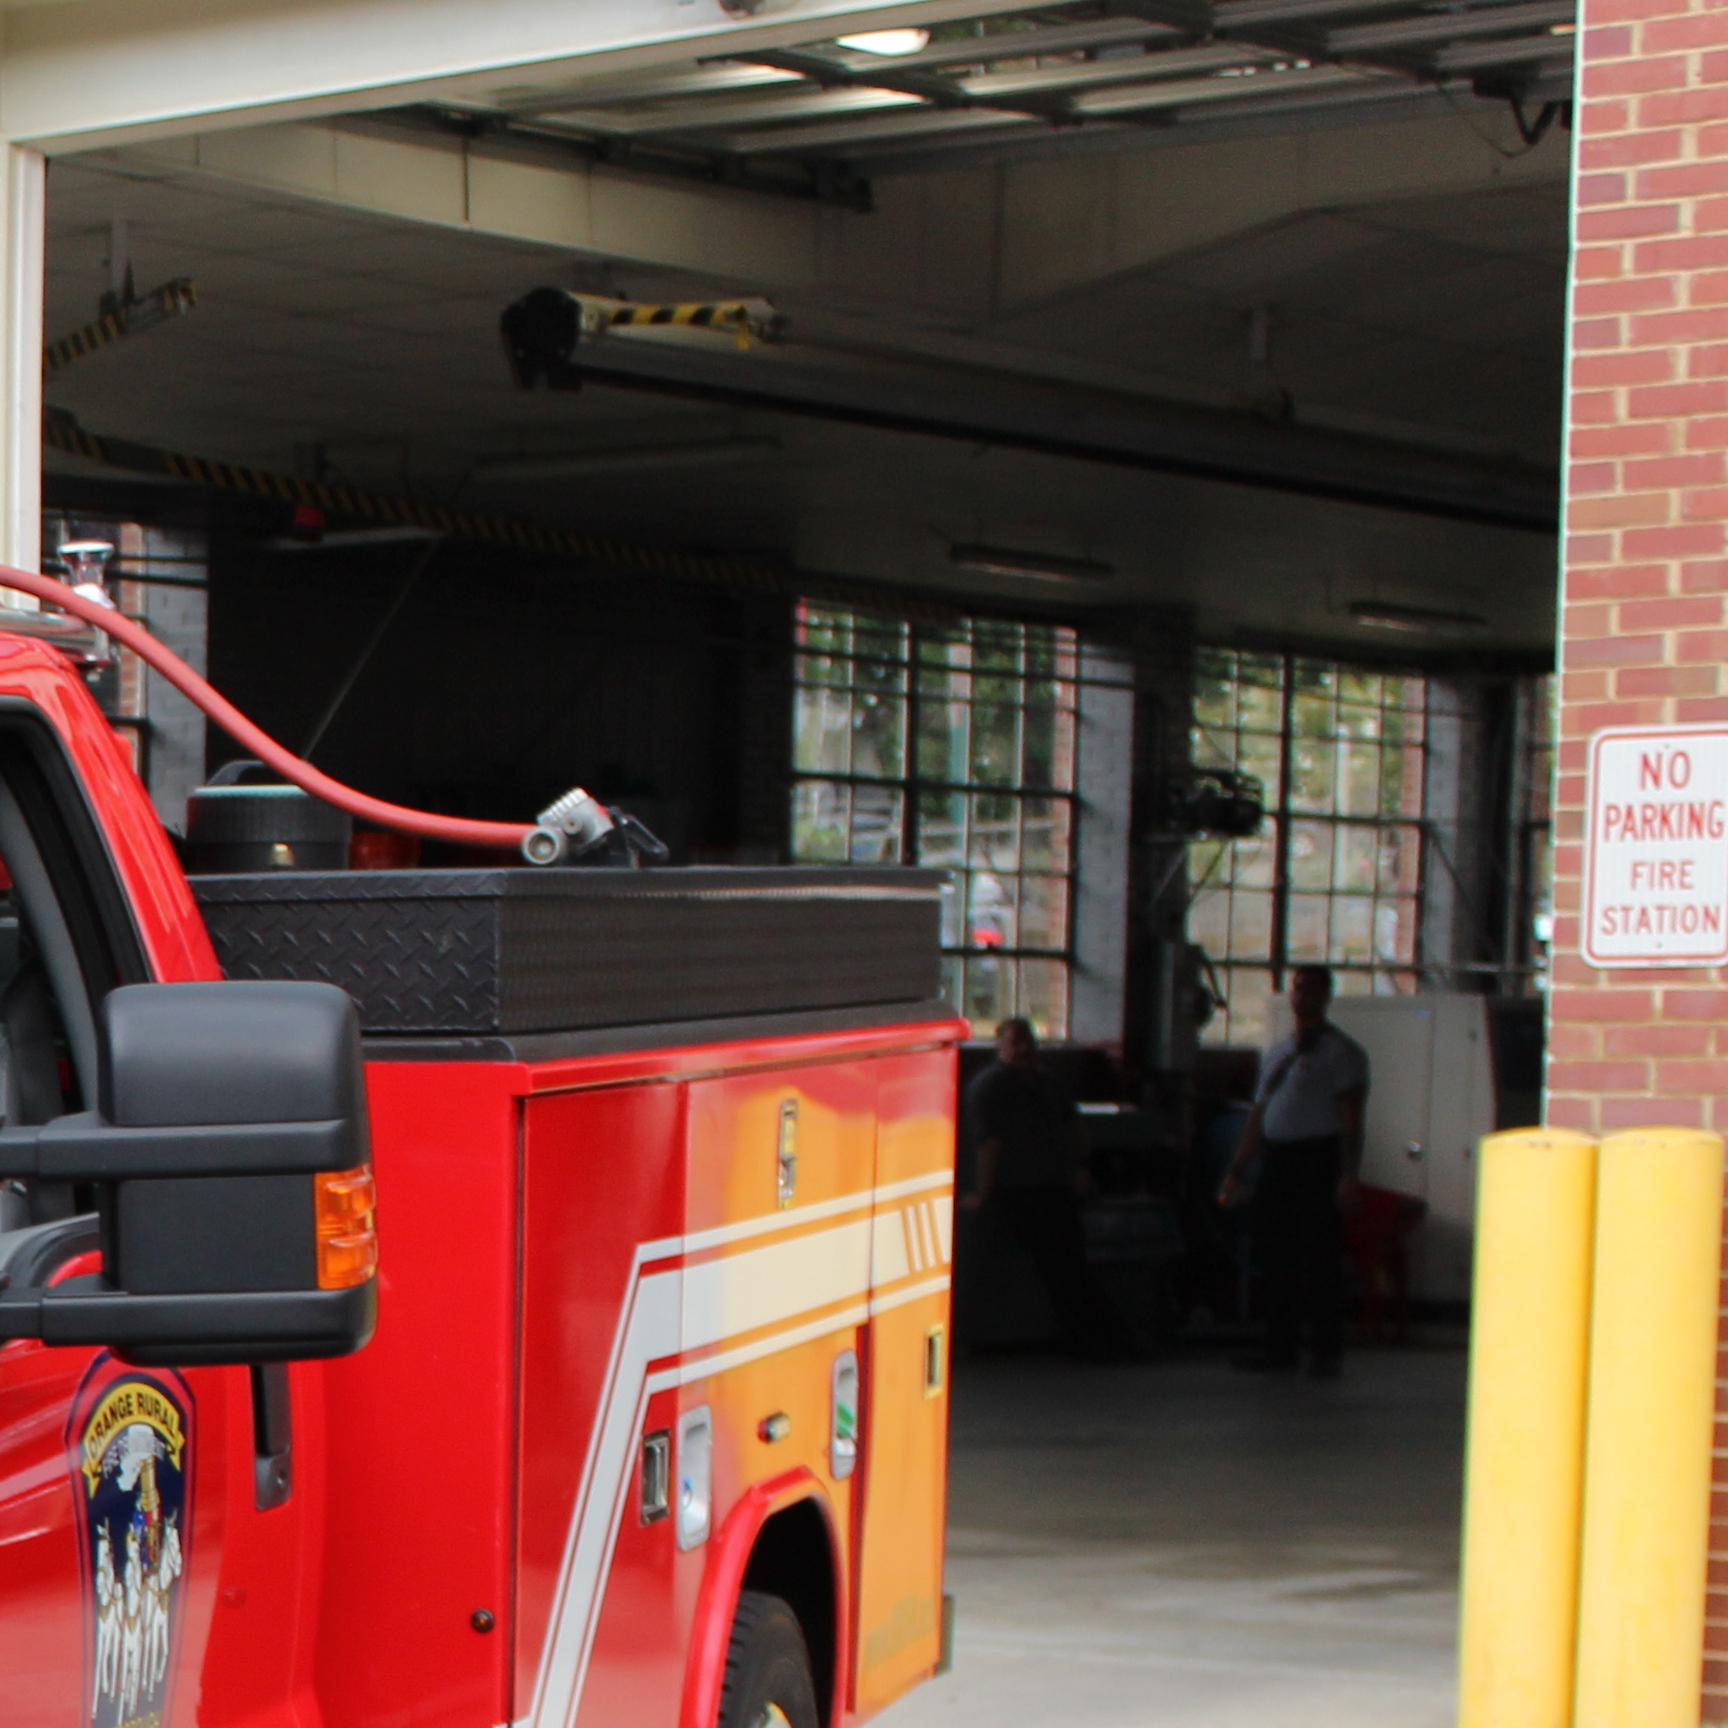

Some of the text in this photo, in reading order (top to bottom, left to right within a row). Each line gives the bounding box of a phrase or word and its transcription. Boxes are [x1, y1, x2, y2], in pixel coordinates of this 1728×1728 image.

[1640, 751, 1691, 790] NO
[1603, 801, 1725, 842] PARKING
[1630, 860, 1695, 890] FIRE
[1600, 904, 1720, 936] STATION
[89, 1392, 133, 1460] ORANGE
[136, 1391, 177, 1438] RURAL
